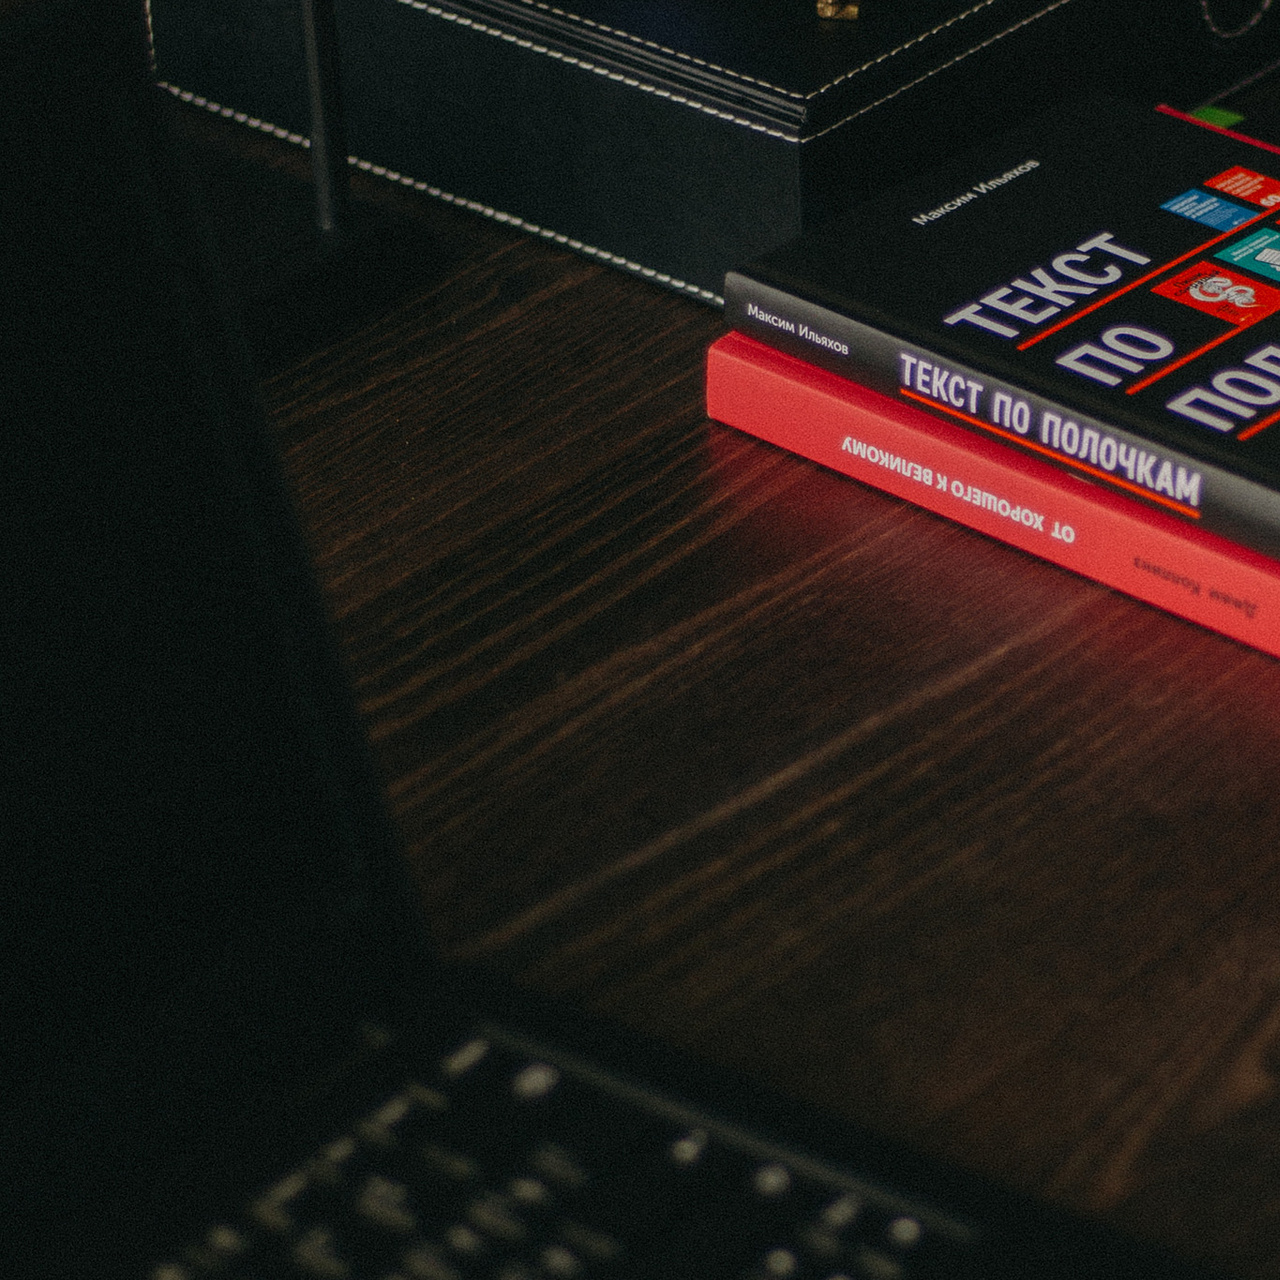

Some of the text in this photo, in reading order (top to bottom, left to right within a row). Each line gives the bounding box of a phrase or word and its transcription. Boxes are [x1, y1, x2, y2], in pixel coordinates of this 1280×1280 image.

[912, 159, 1040, 225] Максим Ильяхов
[943, 231, 1151, 339] ТЕКСТ
[747, 303, 849, 356] Максим Ильяхов
[1055, 326, 1175, 387] ПО
[901, 353, 1202, 507] ТЕКСТ ПО ПОЛОЧКАМ
[841, 435, 1076, 544] ОТ ХОРОШЕГО К ВЕЛИКОМУ
